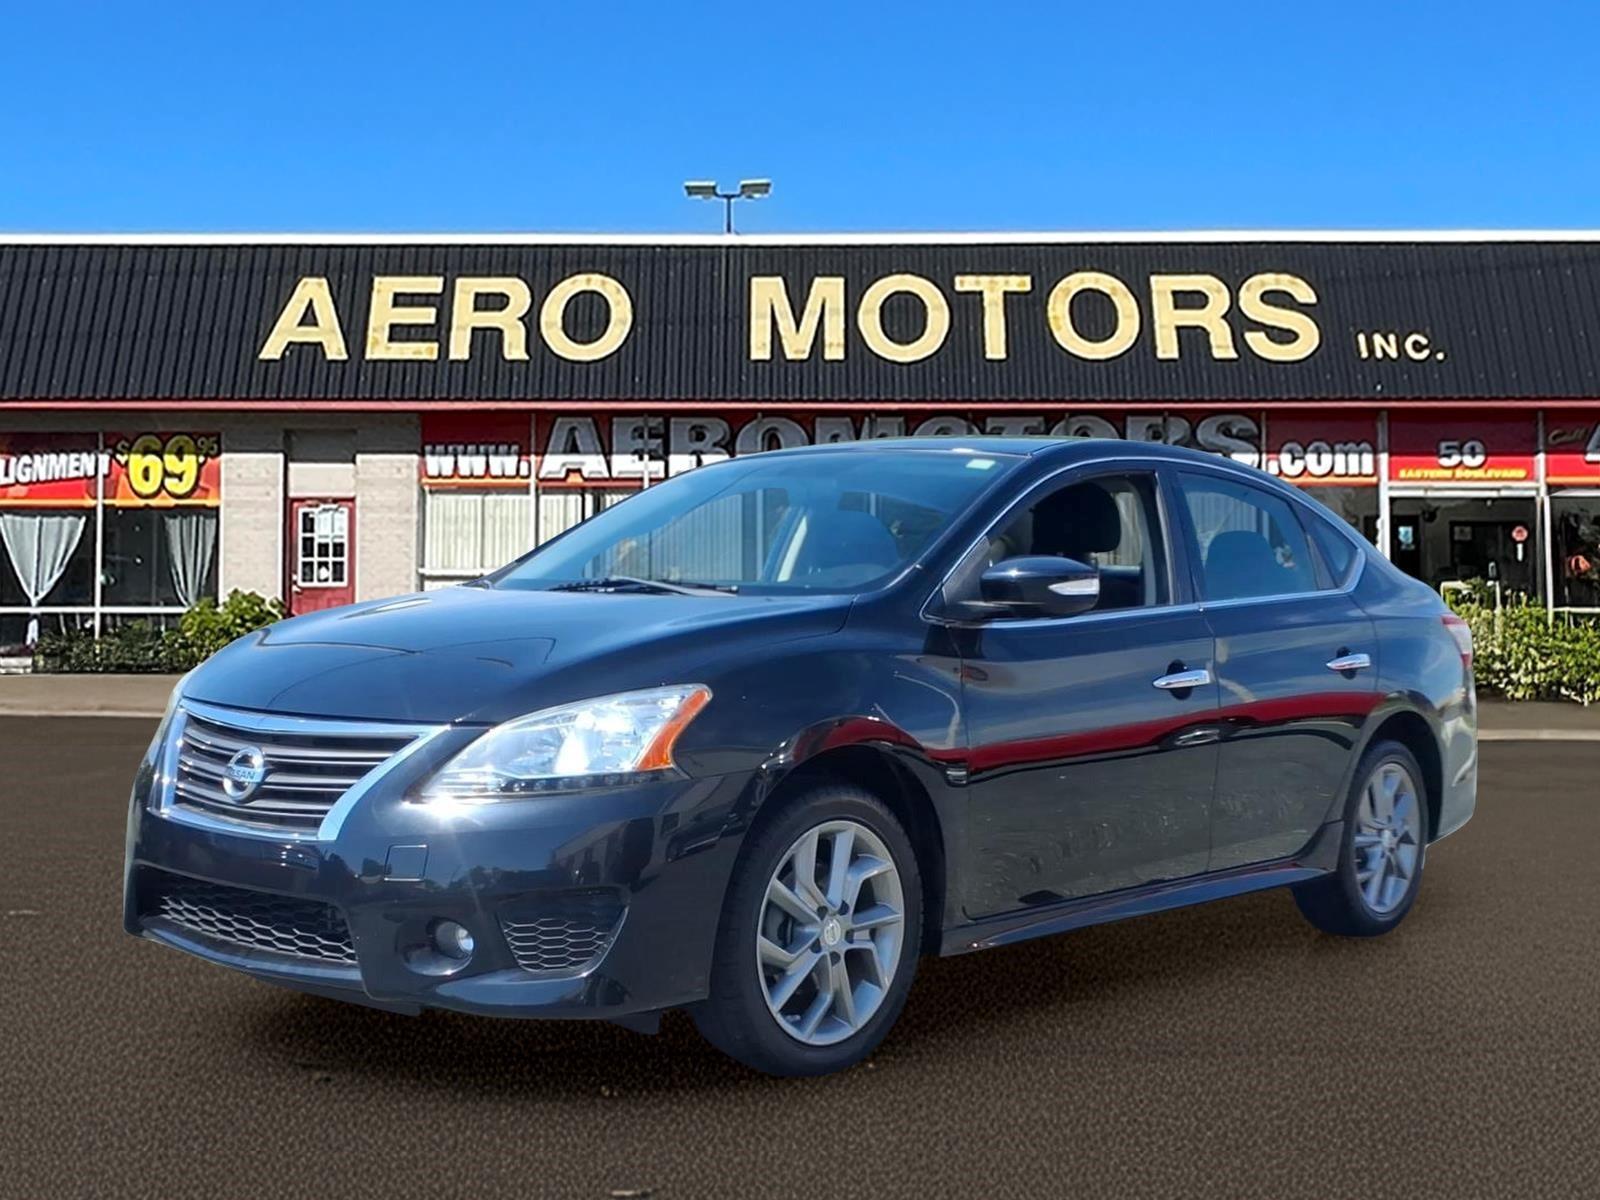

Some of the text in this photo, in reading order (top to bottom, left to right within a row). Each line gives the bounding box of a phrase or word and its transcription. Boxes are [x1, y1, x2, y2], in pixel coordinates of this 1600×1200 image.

[258, 271, 1446, 363] AERO MOTORS INC.
[539, 414, 1261, 478] AEROS
[1438, 440, 1485, 467] 50
[1399, 469, 1527, 479] EASTERN BOULEVARD
